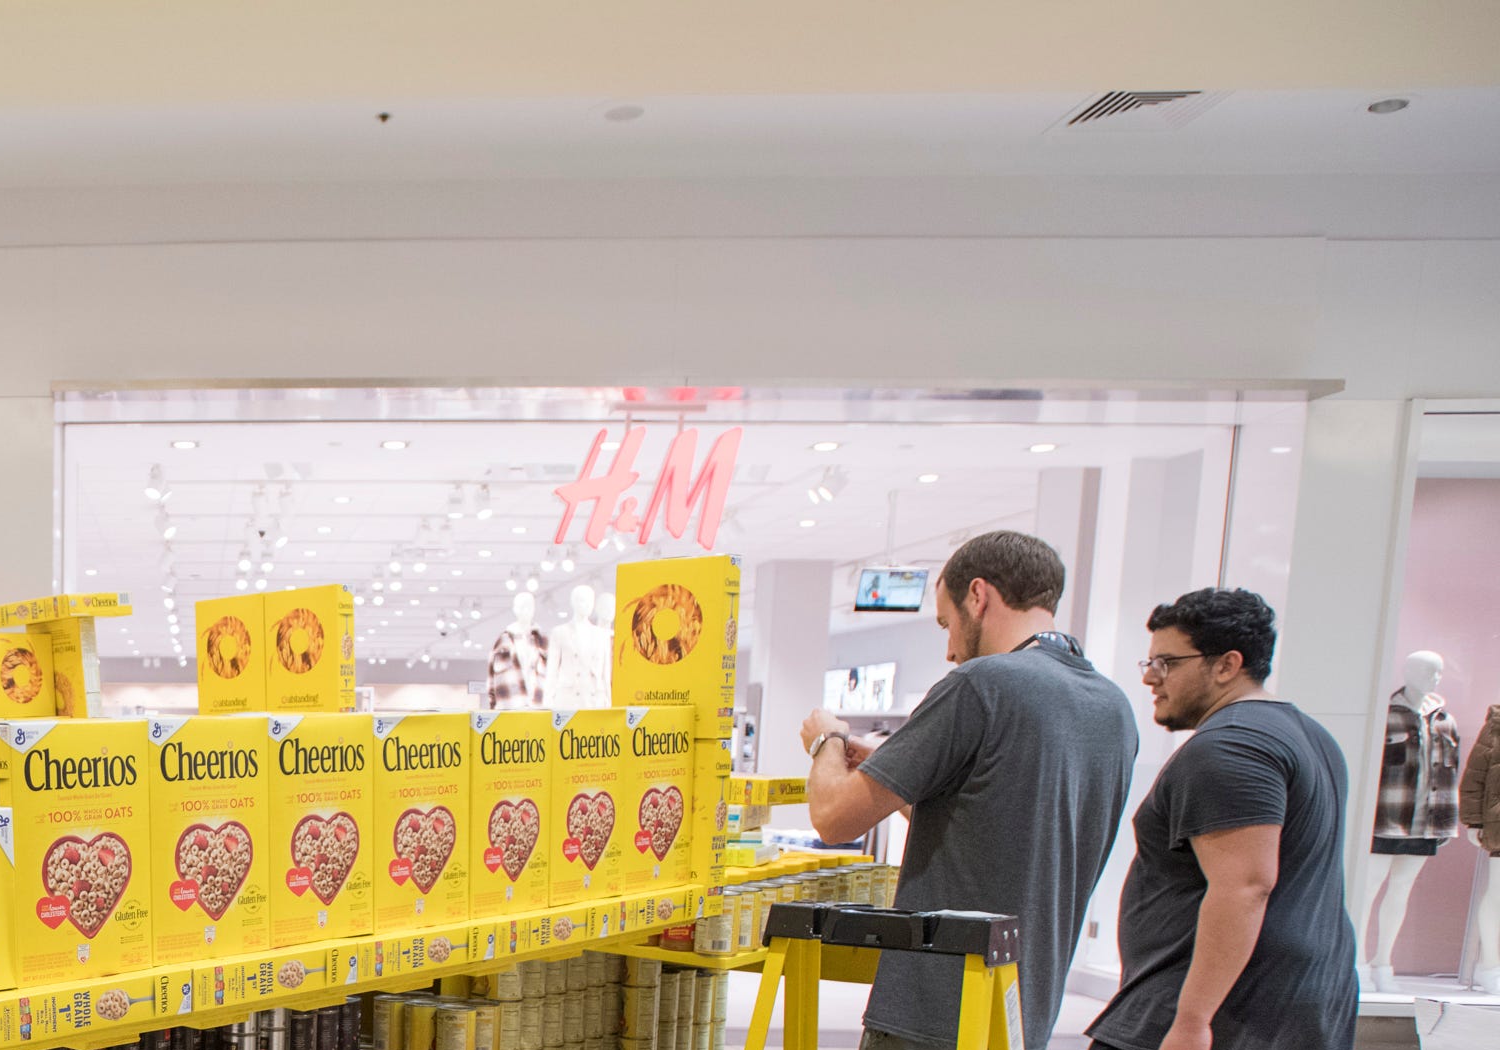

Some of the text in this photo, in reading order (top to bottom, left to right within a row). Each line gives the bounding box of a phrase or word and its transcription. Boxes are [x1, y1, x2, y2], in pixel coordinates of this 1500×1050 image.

[554, 426, 743, 551] H&M
[278, 736, 365, 776] Cheerios
[382, 735, 462, 772] Cheerios
[481, 731, 546, 765] Cheerios
[559, 728, 621, 761] Cheerios
[632, 726, 689, 757] Cheerios
[24, 747, 137, 792] Cheerios
[160, 740, 259, 782] Cheerios
[181, 797, 255, 812] 100% OATS
[296, 789, 362, 804] 100% OATS
[399, 785, 459, 798] 100% OATS
[48, 806, 133, 823] 100% OATS
[115, 909, 149, 922] Gluten Free
[237, 894, 267, 906] Gluten Free
[331, 948, 339, 984] Cheerios
[412, 938, 420, 969] GRAIN
[160, 975, 170, 1013] Cheerios
[247, 973, 257, 990] 1ST
[259, 962, 268, 996] GRAIN
[265, 961, 274, 994] WHOLE
[58, 1004, 72, 1023] 1ST
[73, 992, 83, 1029] GRAIN
[82, 990, 92, 1027] WHOLE
